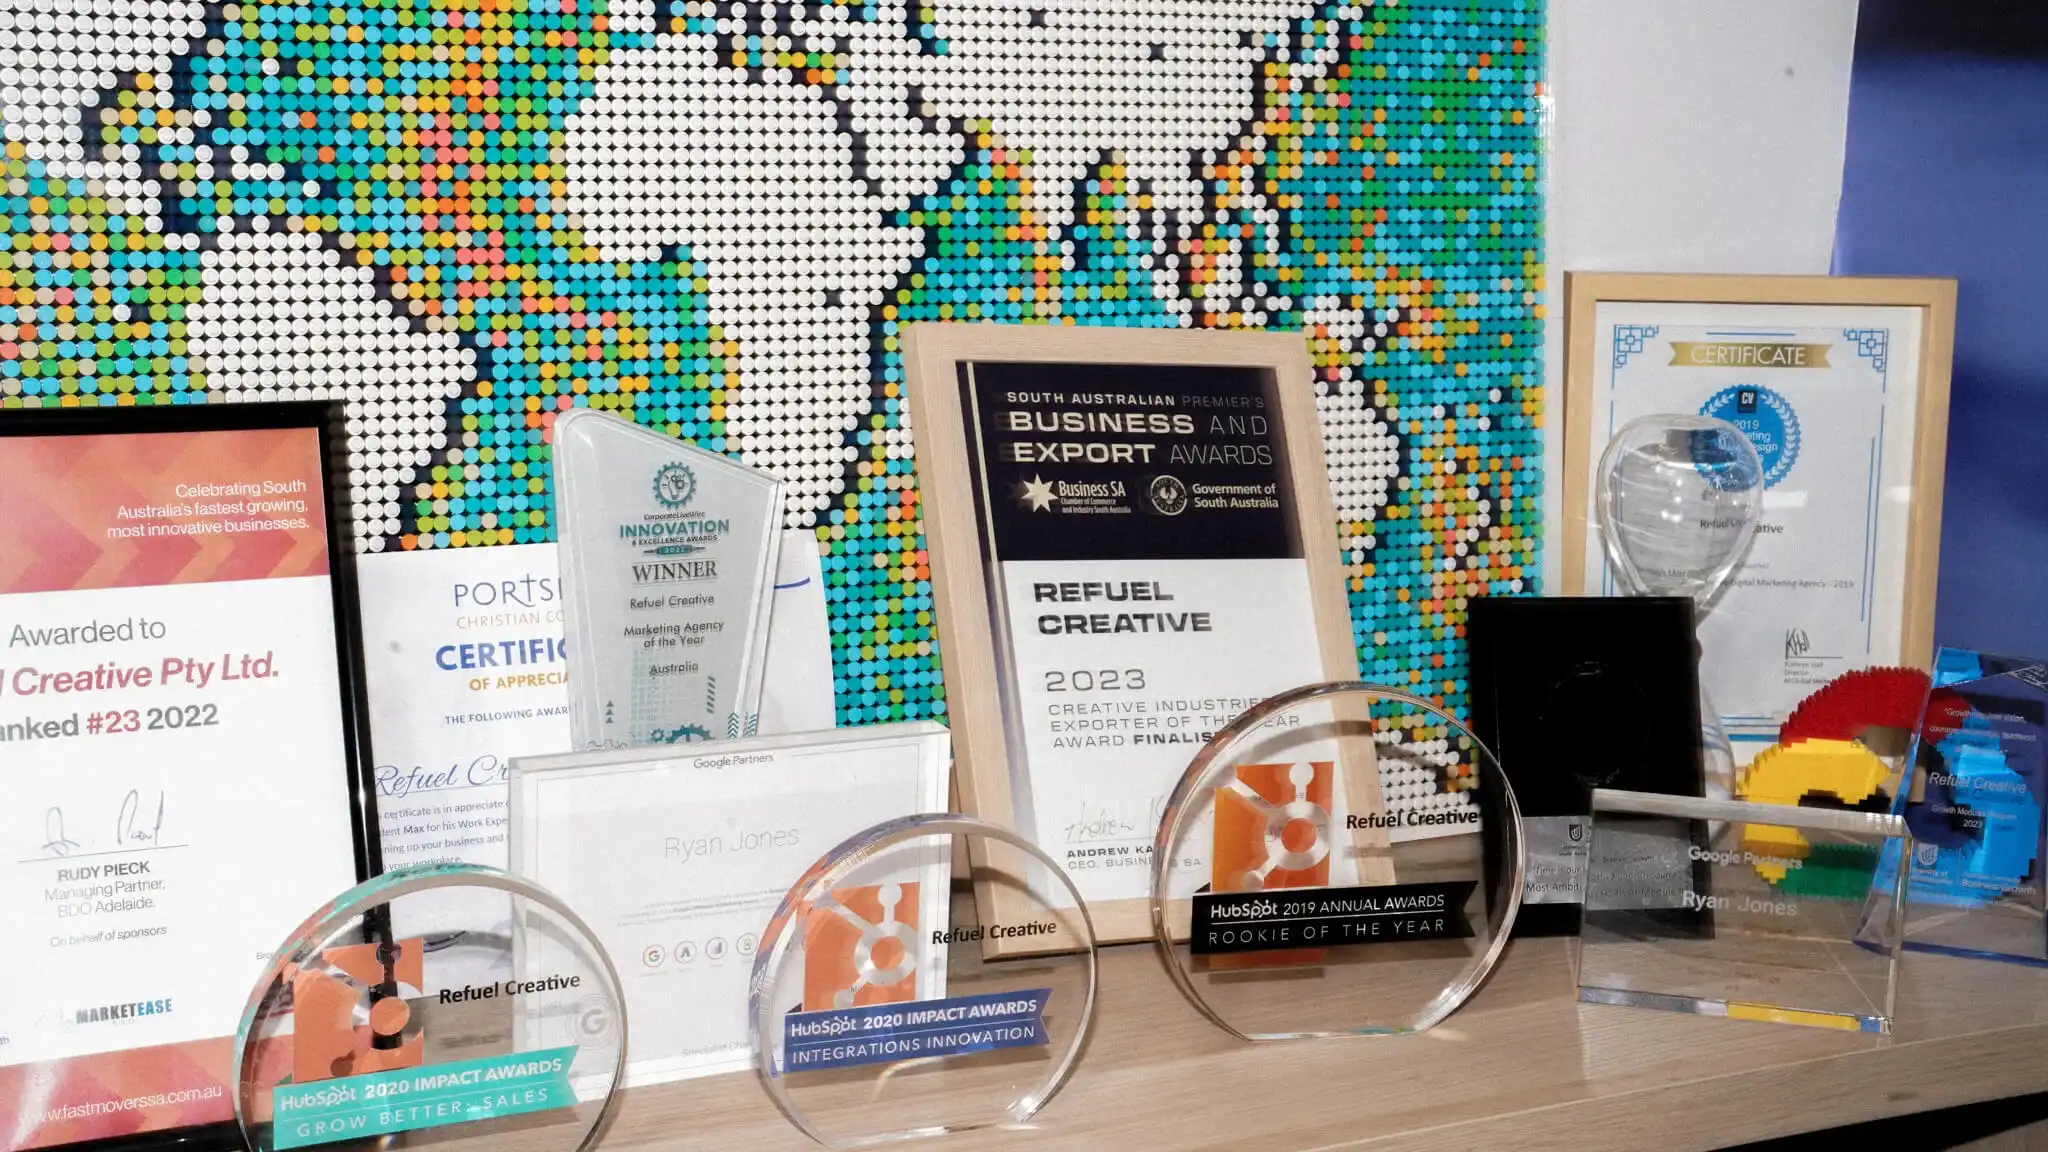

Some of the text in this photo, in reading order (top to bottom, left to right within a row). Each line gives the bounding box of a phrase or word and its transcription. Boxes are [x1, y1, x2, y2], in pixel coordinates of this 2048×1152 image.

[1691, 346, 1805, 365] CERTIFICATE
[1007, 392, 1265, 408] SOUTH AUSTRALIAN PREMIER'S
[1741, 392, 1754, 404] CV
[1009, 411, 1268, 435] BUSINESS AND
[1013, 442, 1273, 465] EXPORT AWARDS
[176, 479, 307, 499] Celebrating South
[1058, 480, 1126, 497] Business SA
[1192, 483, 1276, 495] Government of
[117, 499, 309, 519] Australia's fastest growing,
[1195, 496, 1228, 508] South
[1230, 497, 1280, 509] Australia
[107, 517, 310, 538] most innovative businesses.
[619, 519, 730, 538] INNOVATION
[638, 536, 685, 546] EXCELLENCE
[686, 534, 718, 543] AWARDS
[632, 560, 718, 582] WINNER
[455, 574, 563, 607] PORTSI
[630, 594, 715, 609] Refuel Creative
[1033, 581, 1174, 602] REFUEL
[456, 612, 540, 629] CHRISTIAN
[624, 620, 724, 637] Marketing Agency
[1038, 612, 1213, 635] CREATIVE
[9, 617, 166, 648] Awarded to
[643, 635, 705, 648] of the Year
[436, 638, 567, 671] CERTIFI
[12, 661, 153, 696] Creative
[160, 657, 215, 689] Pty
[221, 651, 280, 681] Ltd.
[649, 661, 699, 675] Australia
[469, 672, 568, 691] OF APPRECI
[1045, 669, 1146, 692] 2023
[445, 706, 569, 725] THE FOLLOWING AWAR
[1048, 697, 1271, 716] CREATIVE INDUSTRIE
[0, 703, 219, 742] anked #23 2022
[1051, 717, 1159, 732] EXPORTER
[1167, 716, 1192, 728] OF
[1263, 715, 1300, 727] EAR
[1053, 731, 1217, 750] AWARD FINALIS
[692, 753, 774, 771] Google Partners
[373, 764, 459, 799] Refuel
[1928, 771, 2027, 794] Refuel Creative
[384, 807, 432, 820] certificate
[434, 806, 442, 814] is
[443, 804, 453, 814] in
[454, 799, 504, 814] appreciate
[1346, 810, 1478, 829] Refuel Creative
[403, 824, 425, 835] Max
[426, 821, 441, 832] for
[442, 819, 456, 830] his
[458, 816, 484, 829] Work
[406, 842, 419, 854] up
[420, 839, 442, 852] your
[445, 834, 485, 848] business
[487, 832, 504, 843] and
[664, 826, 800, 864] Ryan Jones
[1067, 846, 1130, 858] ANDREW
[1688, 845, 1803, 869] Google Partners
[57, 860, 151, 882] RUDY PIECK
[45, 878, 166, 902] Managing Partner,
[57, 896, 156, 918] BDO Adelaide.
[1211, 895, 1445, 920] HubSpot 2019 ANNUAL AWARDS
[1682, 890, 1730, 912] Ryan
[1737, 897, 1798, 917] Jones
[49, 926, 167, 948] On behalf of sponsors
[932, 919, 1057, 945] Refuel Creative
[1208, 919, 1444, 946] ROOKIE OF THE YEAR
[440, 974, 580, 1005] Refuel Creative
[76, 998, 173, 1025] MARKETEASE
[791, 999, 1037, 1038] HubSpot 2020 IMPACT AWARDS
[793, 1025, 1035, 1065] INTEGRATIONS INNOVATION
[280, 1058, 562, 1111] HubSpot 2020 IMPACT AWARDS
[297, 1116, 366, 1138] GROW
[483, 1088, 548, 1111] SALES
